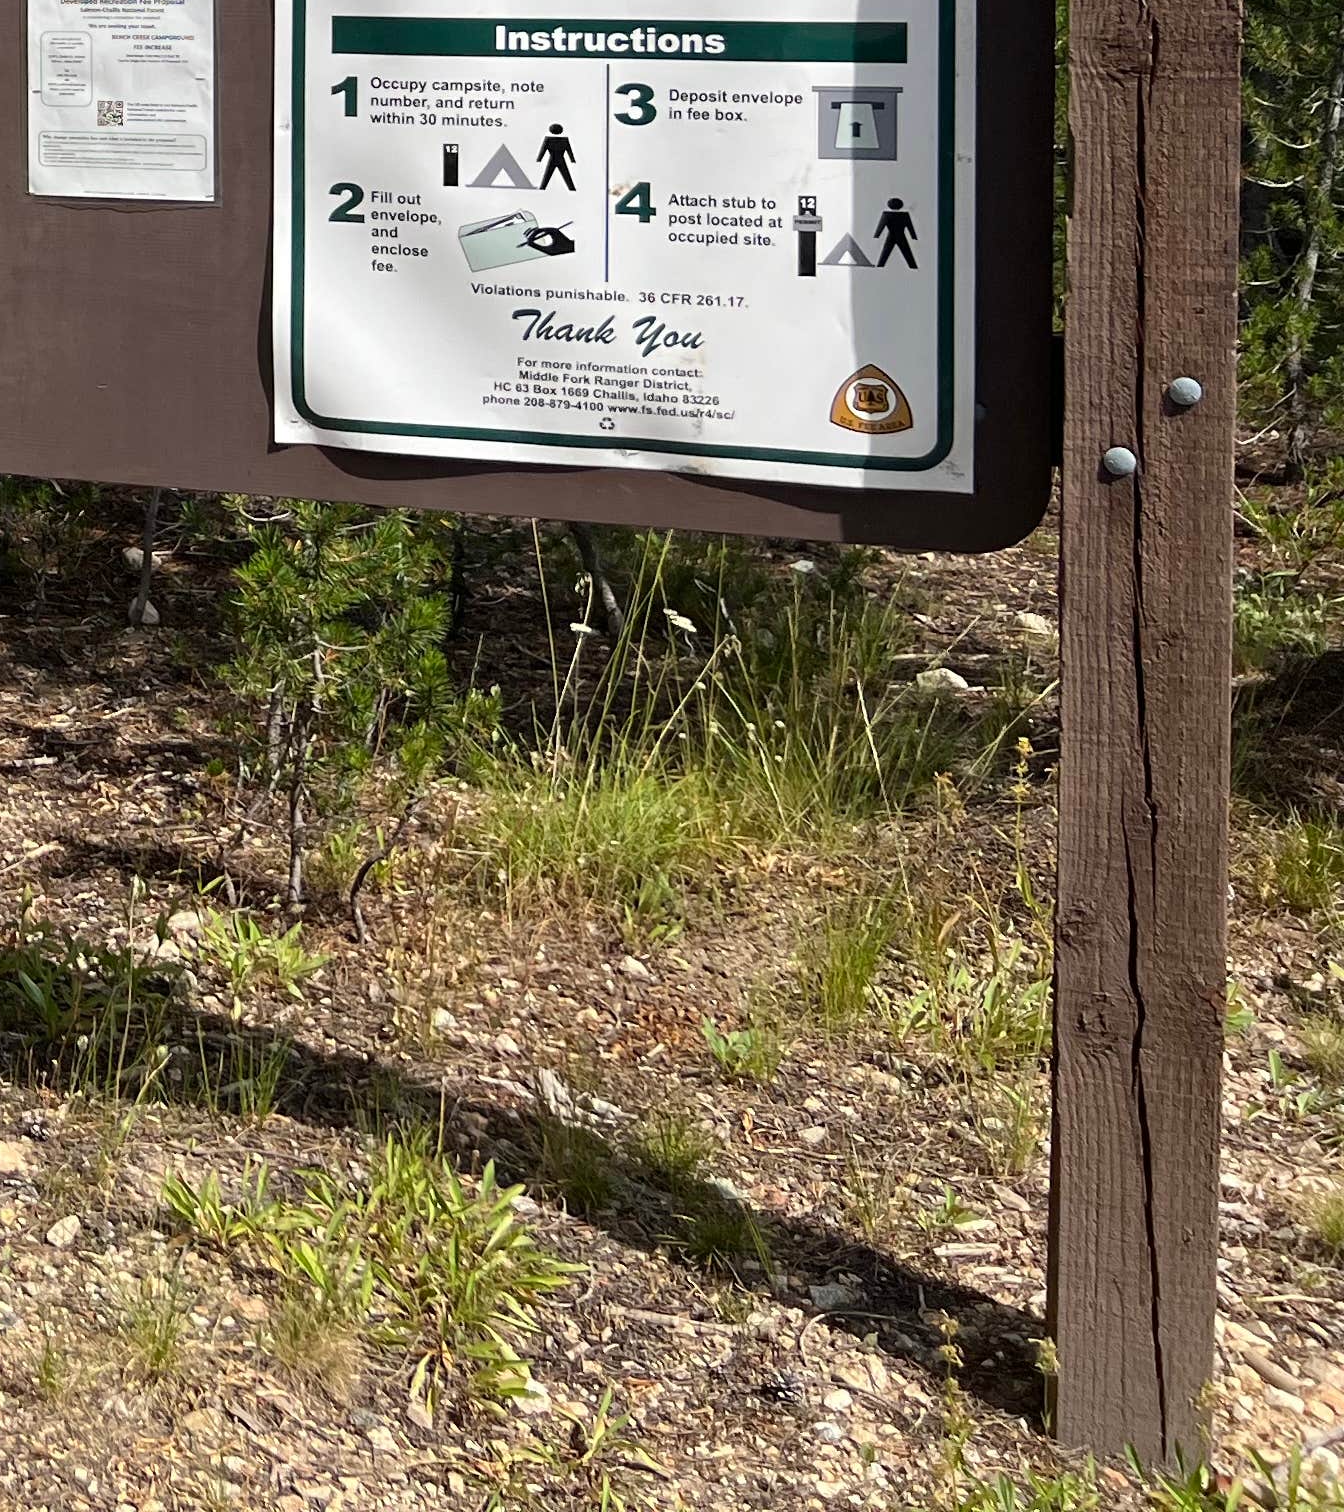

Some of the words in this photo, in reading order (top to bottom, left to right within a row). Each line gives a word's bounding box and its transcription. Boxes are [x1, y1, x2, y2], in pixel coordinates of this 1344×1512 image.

[495, 25, 726, 54] Instructions
[614, 83, 657, 126] 3
[669, 89, 727, 103] Deposit
[732, 91, 803, 107] envelope
[669, 107, 682, 119] in
[688, 108, 710, 120] fee
[715, 109, 748, 122] box.
[615, 182, 656, 223] 4
[669, 194, 716, 208] Attach
[722, 197, 756, 209] stub
[762, 197, 776, 209] to
[668, 214, 701, 226] post
[707, 214, 763, 227] located
[769, 217, 782, 228] at
[669, 232, 737, 246] occupied
[744, 233, 776, 247] site.
[471, 282, 540, 297] Violations
[546, 290, 629, 302] punishable.
[639, 292, 655, 302] 36
[661, 293, 691, 304] CFR
[697, 295, 748, 308] 261.17.
[512, 309, 616, 344] Thank
[632, 316, 704, 357] You
[517, 357, 538, 366] For
[542, 360, 572, 370] more
[576, 361, 647, 374] information
[652, 369, 703, 377] contact:
[519, 370, 558, 382] Middle
[563, 374, 590, 384] Fork
[595, 376, 639, 389] Ranger
[643, 379, 692, 392] District,
